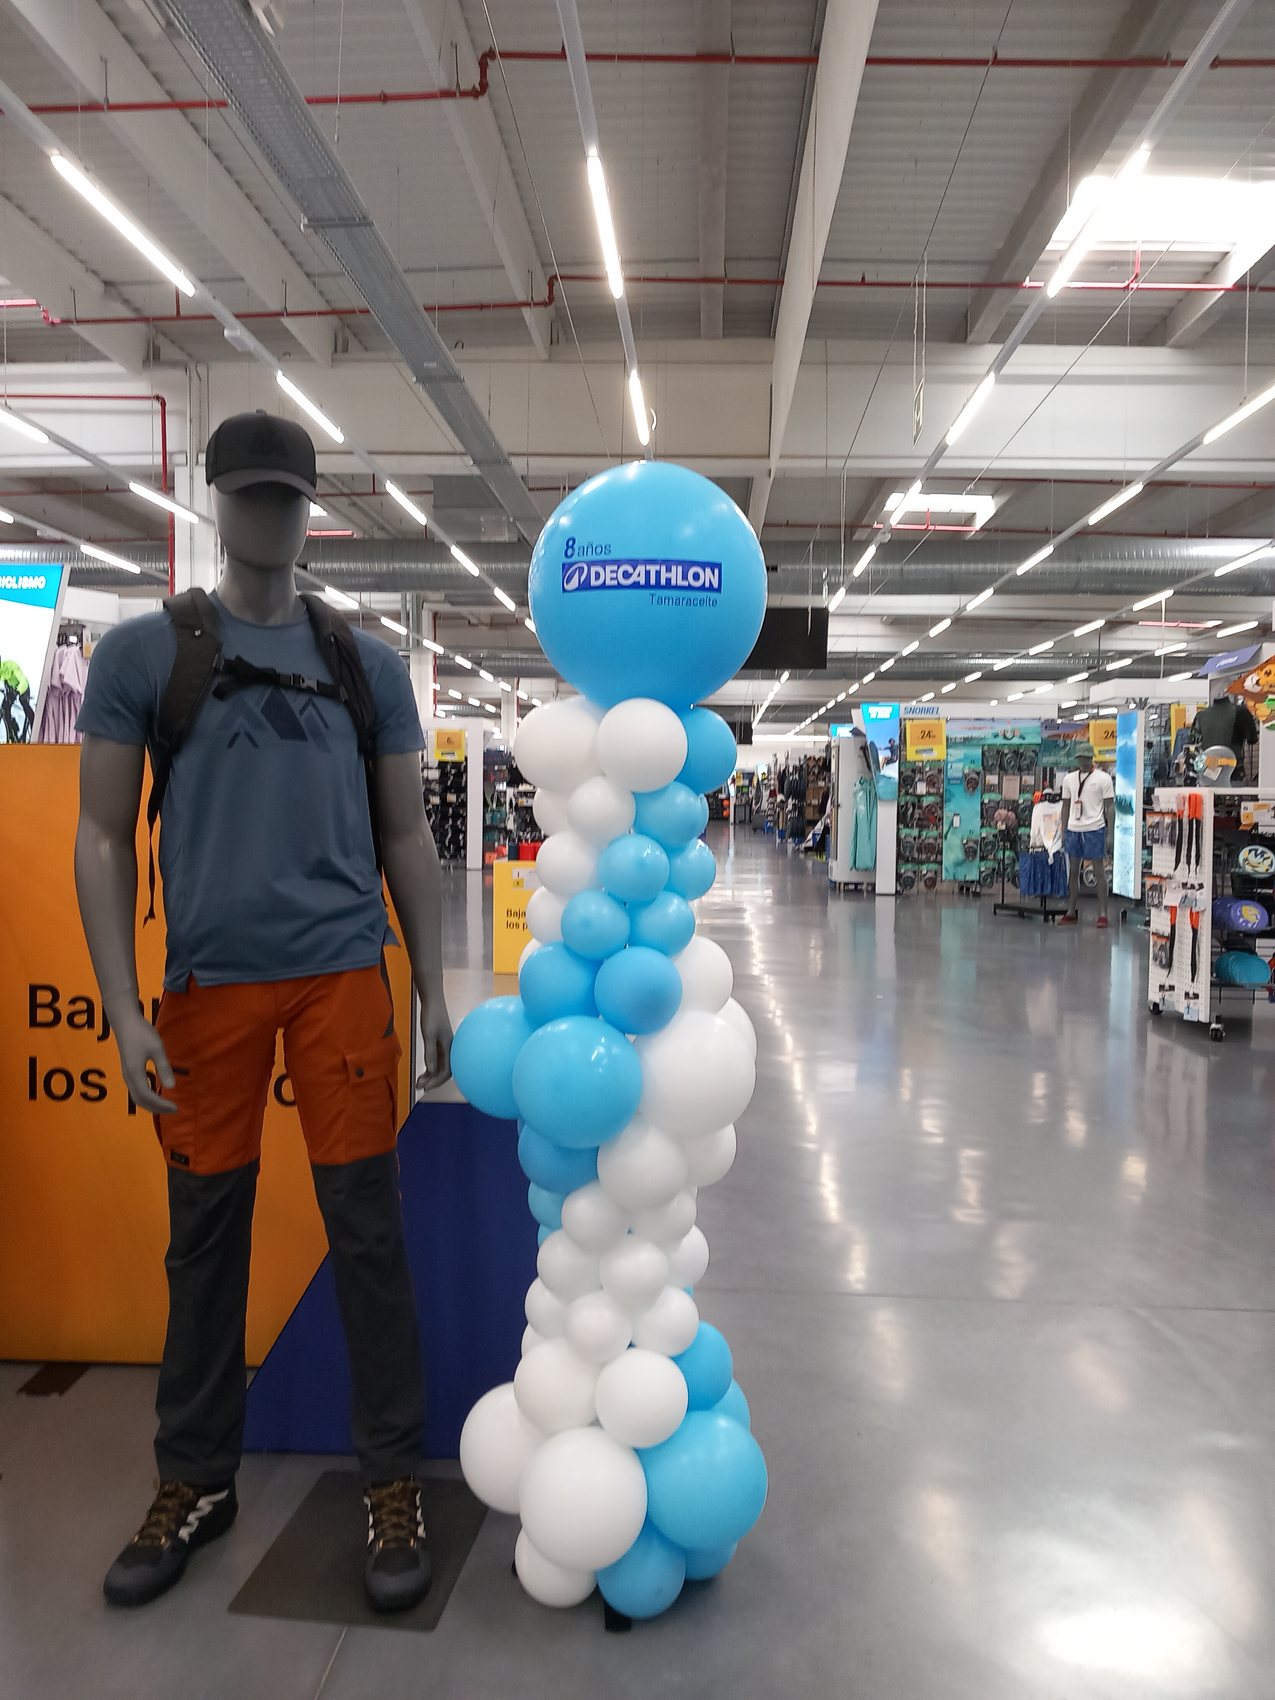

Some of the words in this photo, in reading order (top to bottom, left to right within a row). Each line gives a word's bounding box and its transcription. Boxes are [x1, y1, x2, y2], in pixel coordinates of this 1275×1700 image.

[564, 537, 576, 558] 8
[577, 543, 611, 557] años
[590, 563, 719, 589] DECATHLON
[650, 593, 718, 608] Tamaraceite
[904, 706, 939, 715] SNORKEL
[28, 1056, 108, 1102] los
